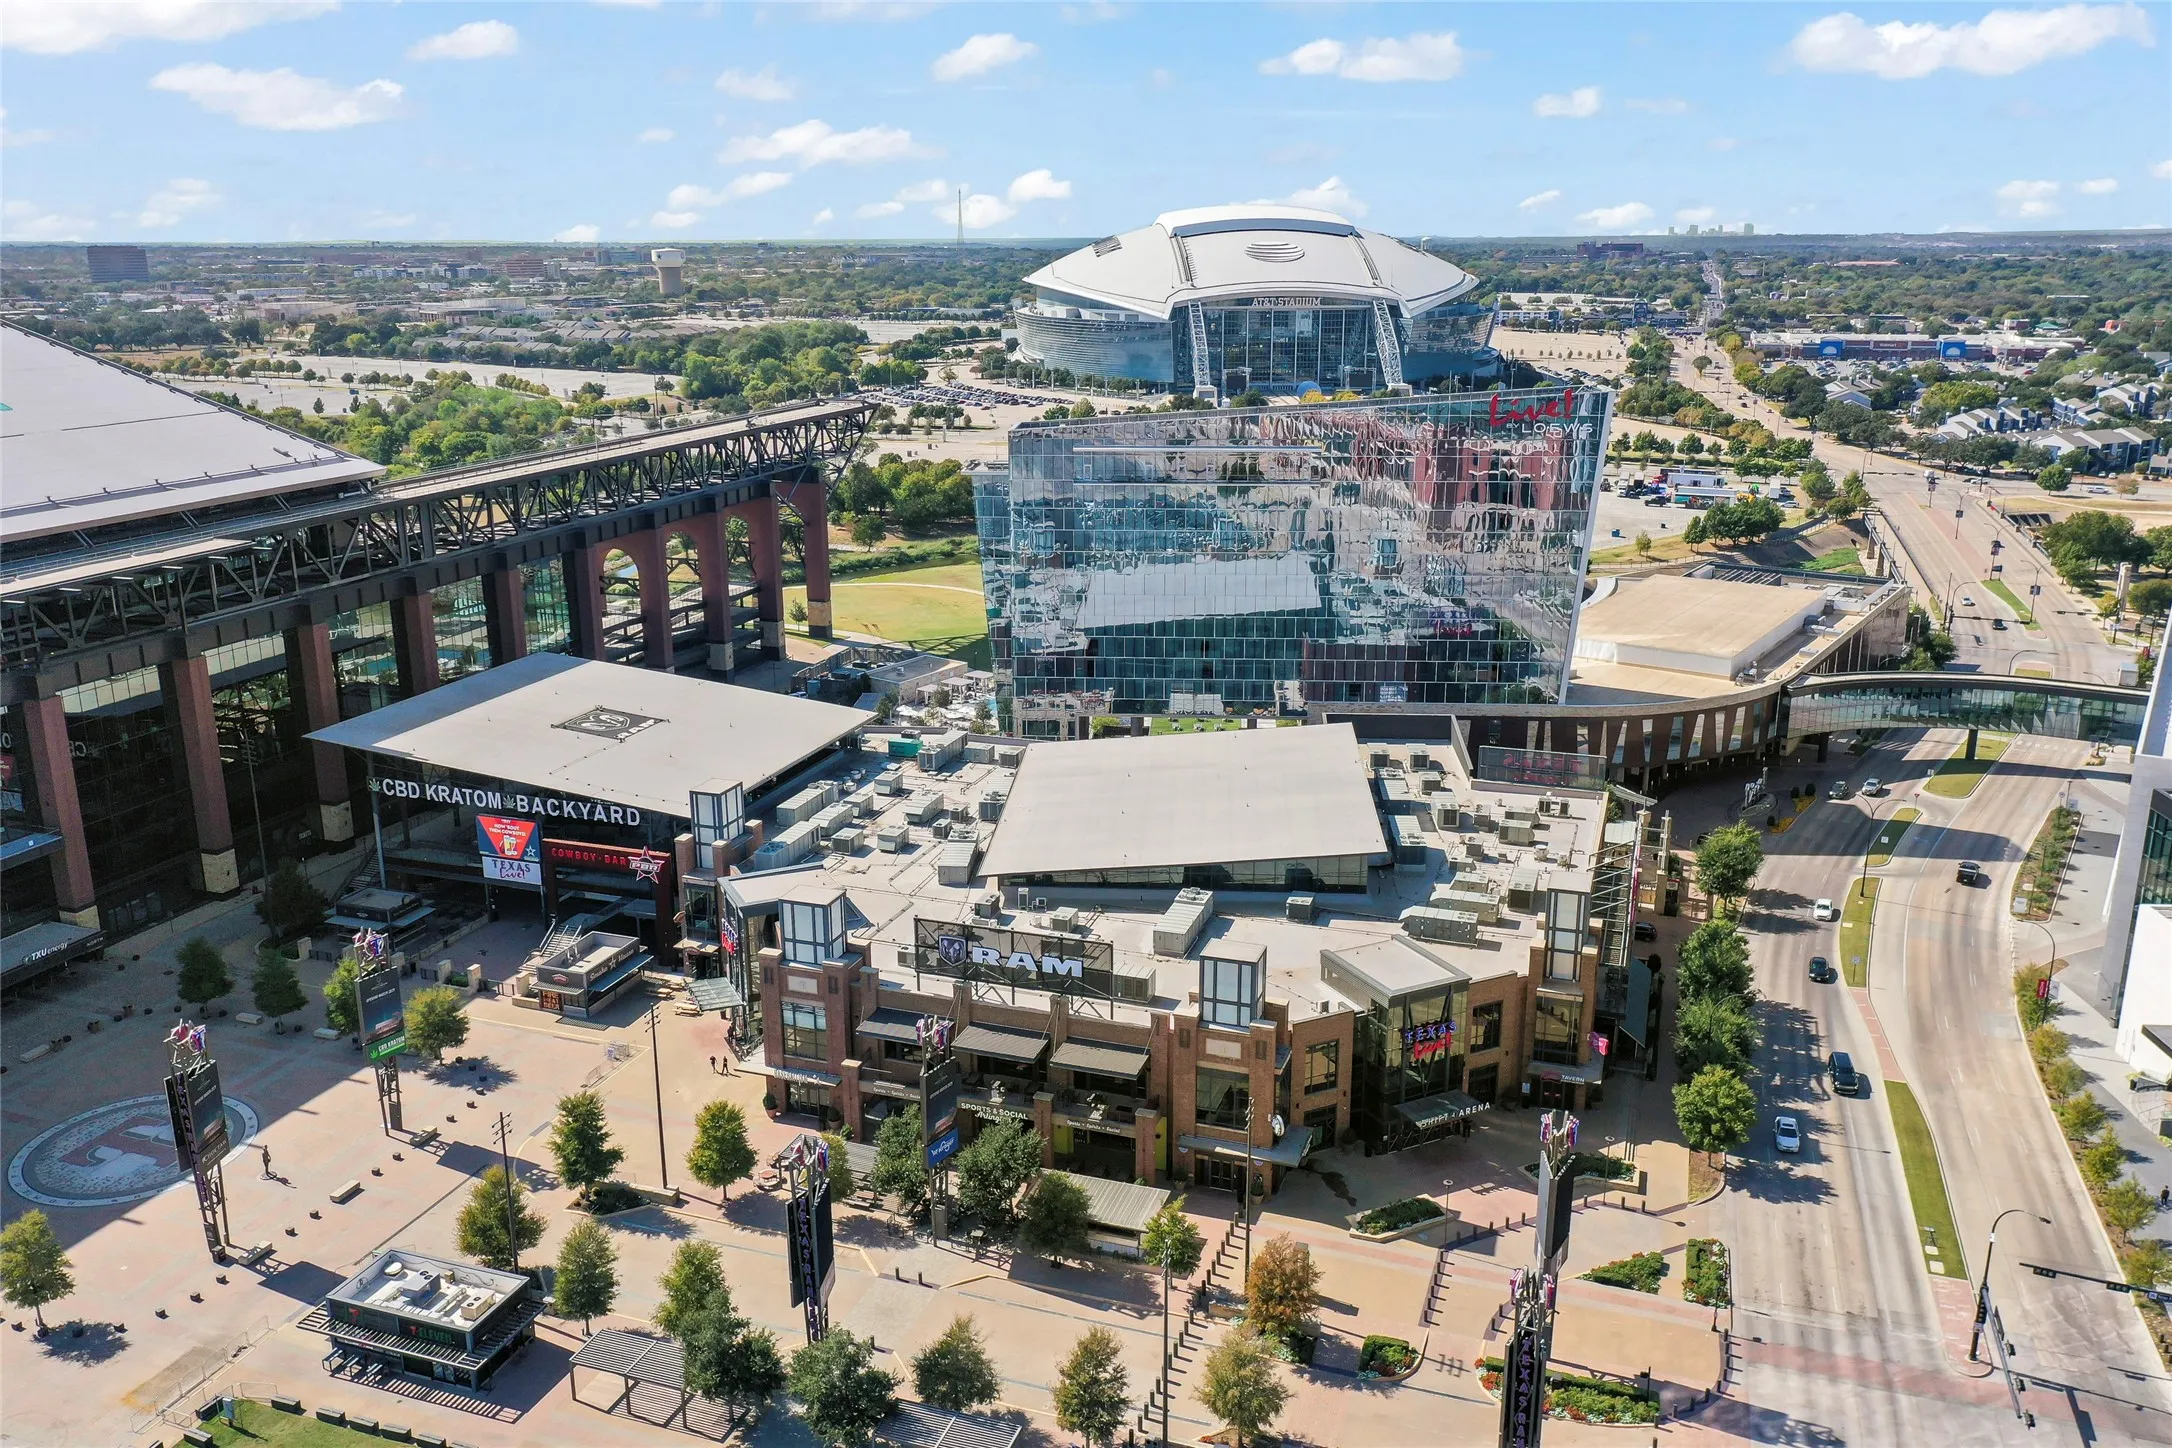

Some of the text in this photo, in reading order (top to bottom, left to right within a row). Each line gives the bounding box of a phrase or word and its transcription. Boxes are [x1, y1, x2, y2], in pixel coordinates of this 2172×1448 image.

[1252, 297, 1320, 306] AT&T STADIUM
[1489, 388, 1573, 427] Live!
[1522, 423, 1593, 433] LOEWS
[382, 778, 641, 826] CBD KRATOM BACKYARD
[551, 847, 627, 865] COWBOY BAR
[491, 860, 531, 872] TEXAS
[31, 941, 69, 961] TXU energy
[972, 945, 1083, 978] RAM
[1405, 1021, 1457, 1044] TEXAS
[1561, 1074, 1585, 1082] TAVERN
[961, 1102, 991, 1113] SPORTS
[999, 1108, 1028, 1120] SOCIAL
[1458, 1101, 1491, 1118] ARENA
[1519, 1340, 1531, 1407] TEXAS
